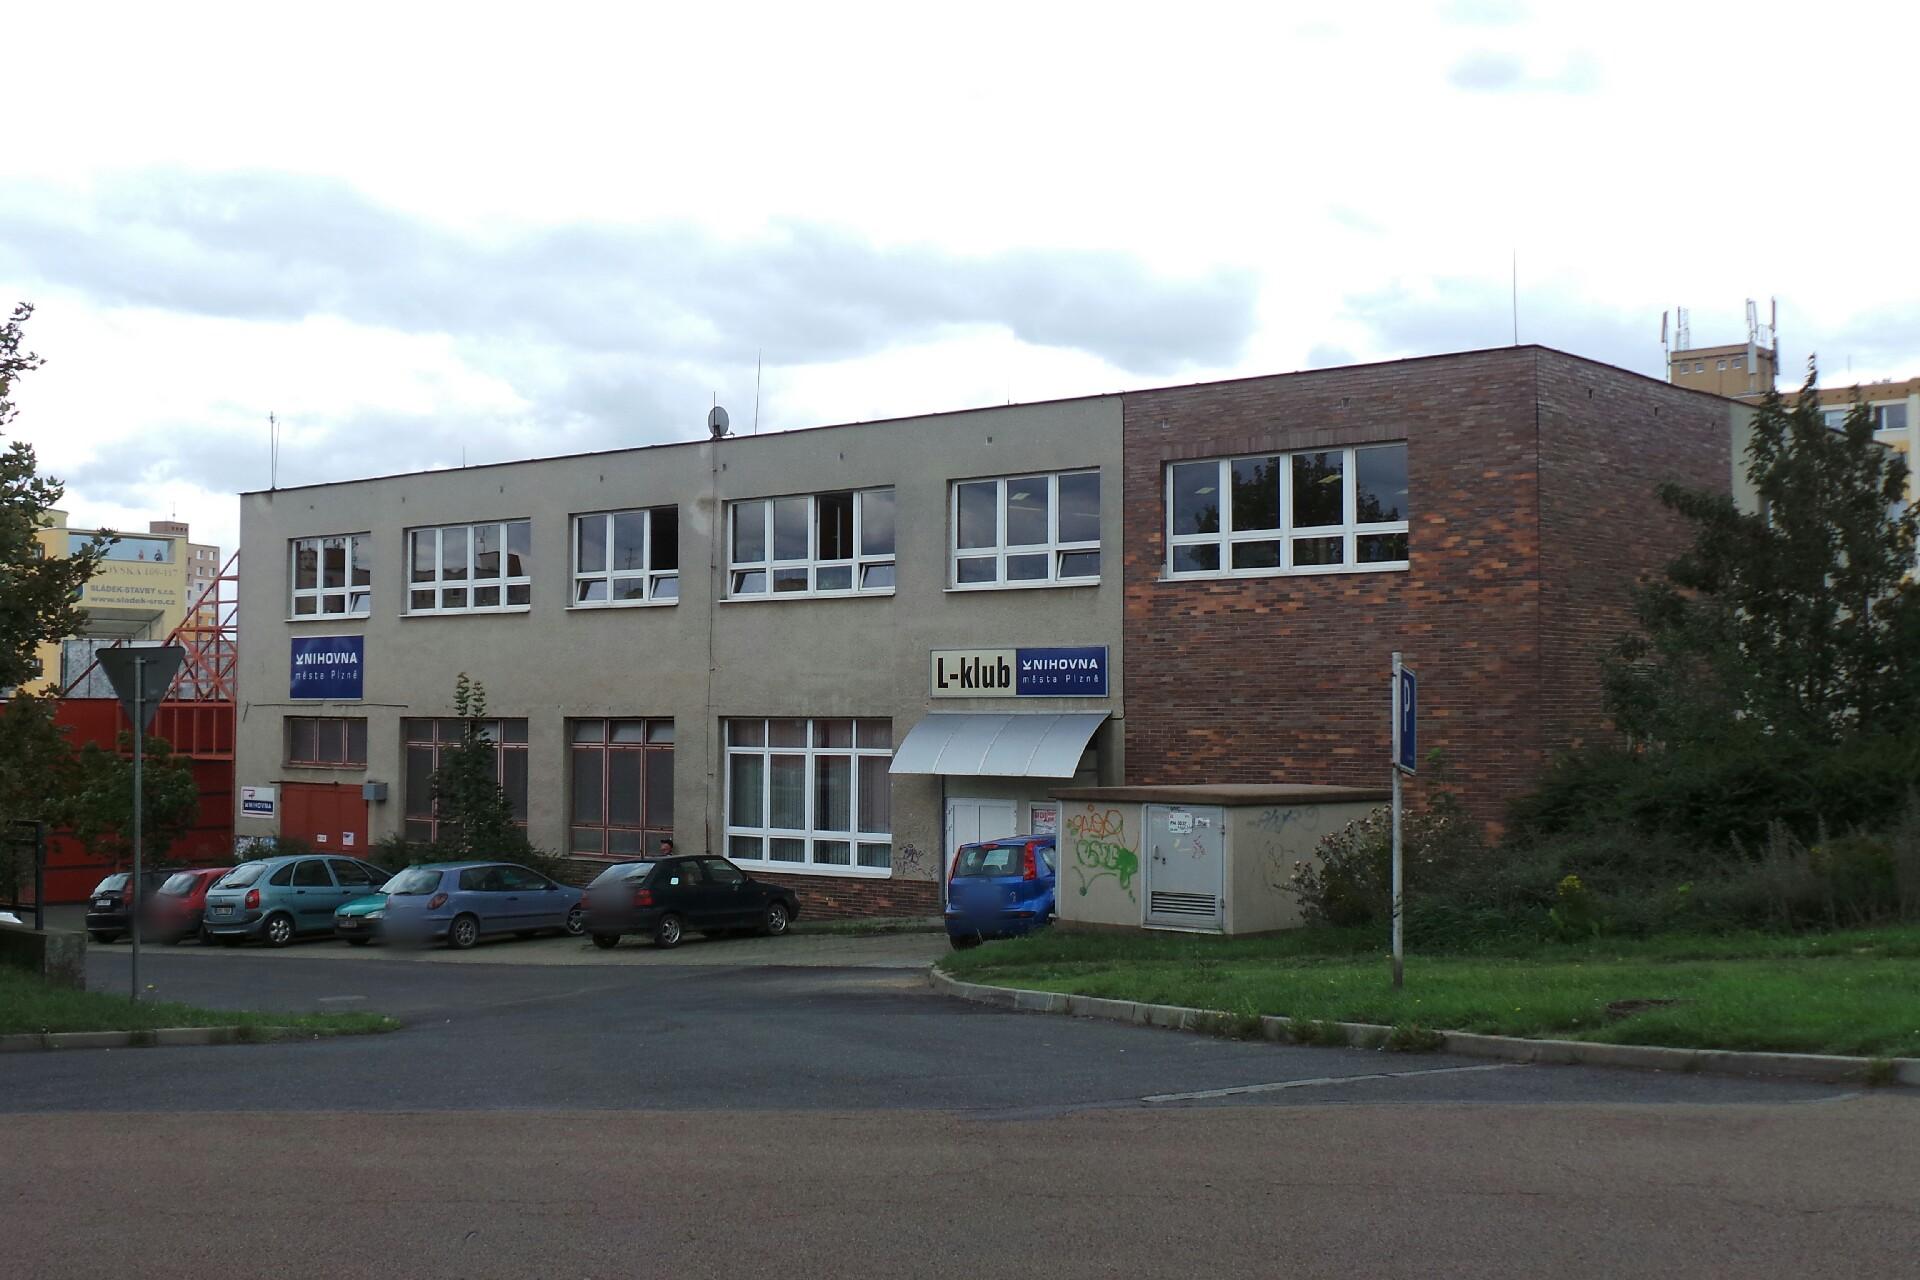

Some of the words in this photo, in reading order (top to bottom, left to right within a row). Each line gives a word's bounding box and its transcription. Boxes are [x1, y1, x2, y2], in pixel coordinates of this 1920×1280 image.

[296, 652, 358, 665] KNIHOVNA
[1022, 658, 1099, 671] KNIHOVNA
[295, 670, 325, 680] města
[331, 669, 358, 680] Plzně
[937, 656, 1011, 689] L-klub
[1022, 673, 1057, 684] města
[1065, 673, 1099, 684] Plzně
[1404, 679, 1411, 732] P
